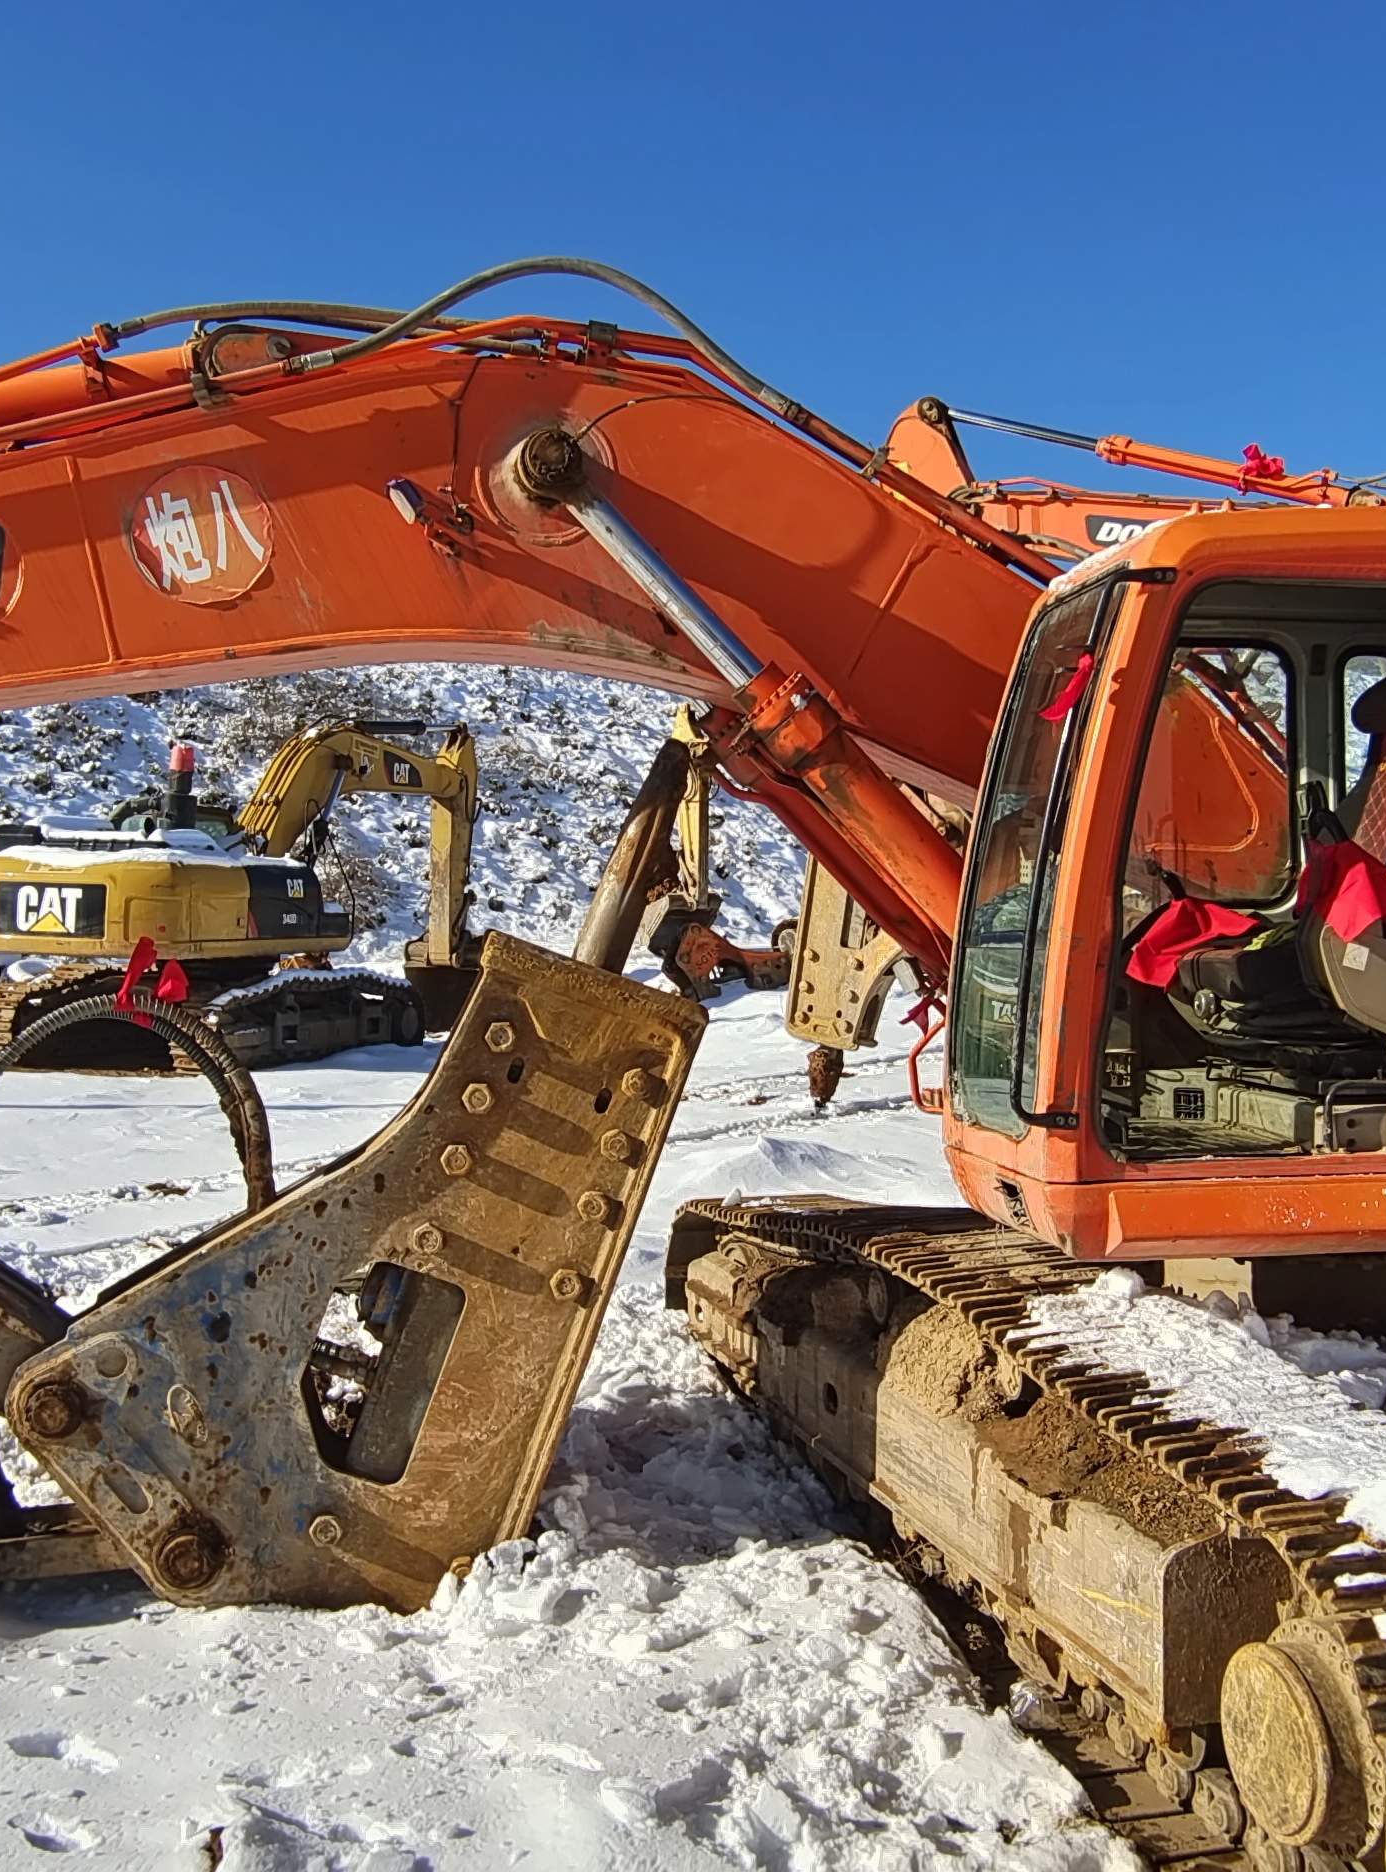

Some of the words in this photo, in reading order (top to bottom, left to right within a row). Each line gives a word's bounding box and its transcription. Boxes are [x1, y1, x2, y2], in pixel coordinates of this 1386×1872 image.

[145, 480, 264, 591] 炮八
[394, 763, 410, 784] CAT
[286, 878, 304, 898] CAT
[16, 885, 83, 934] CAT
